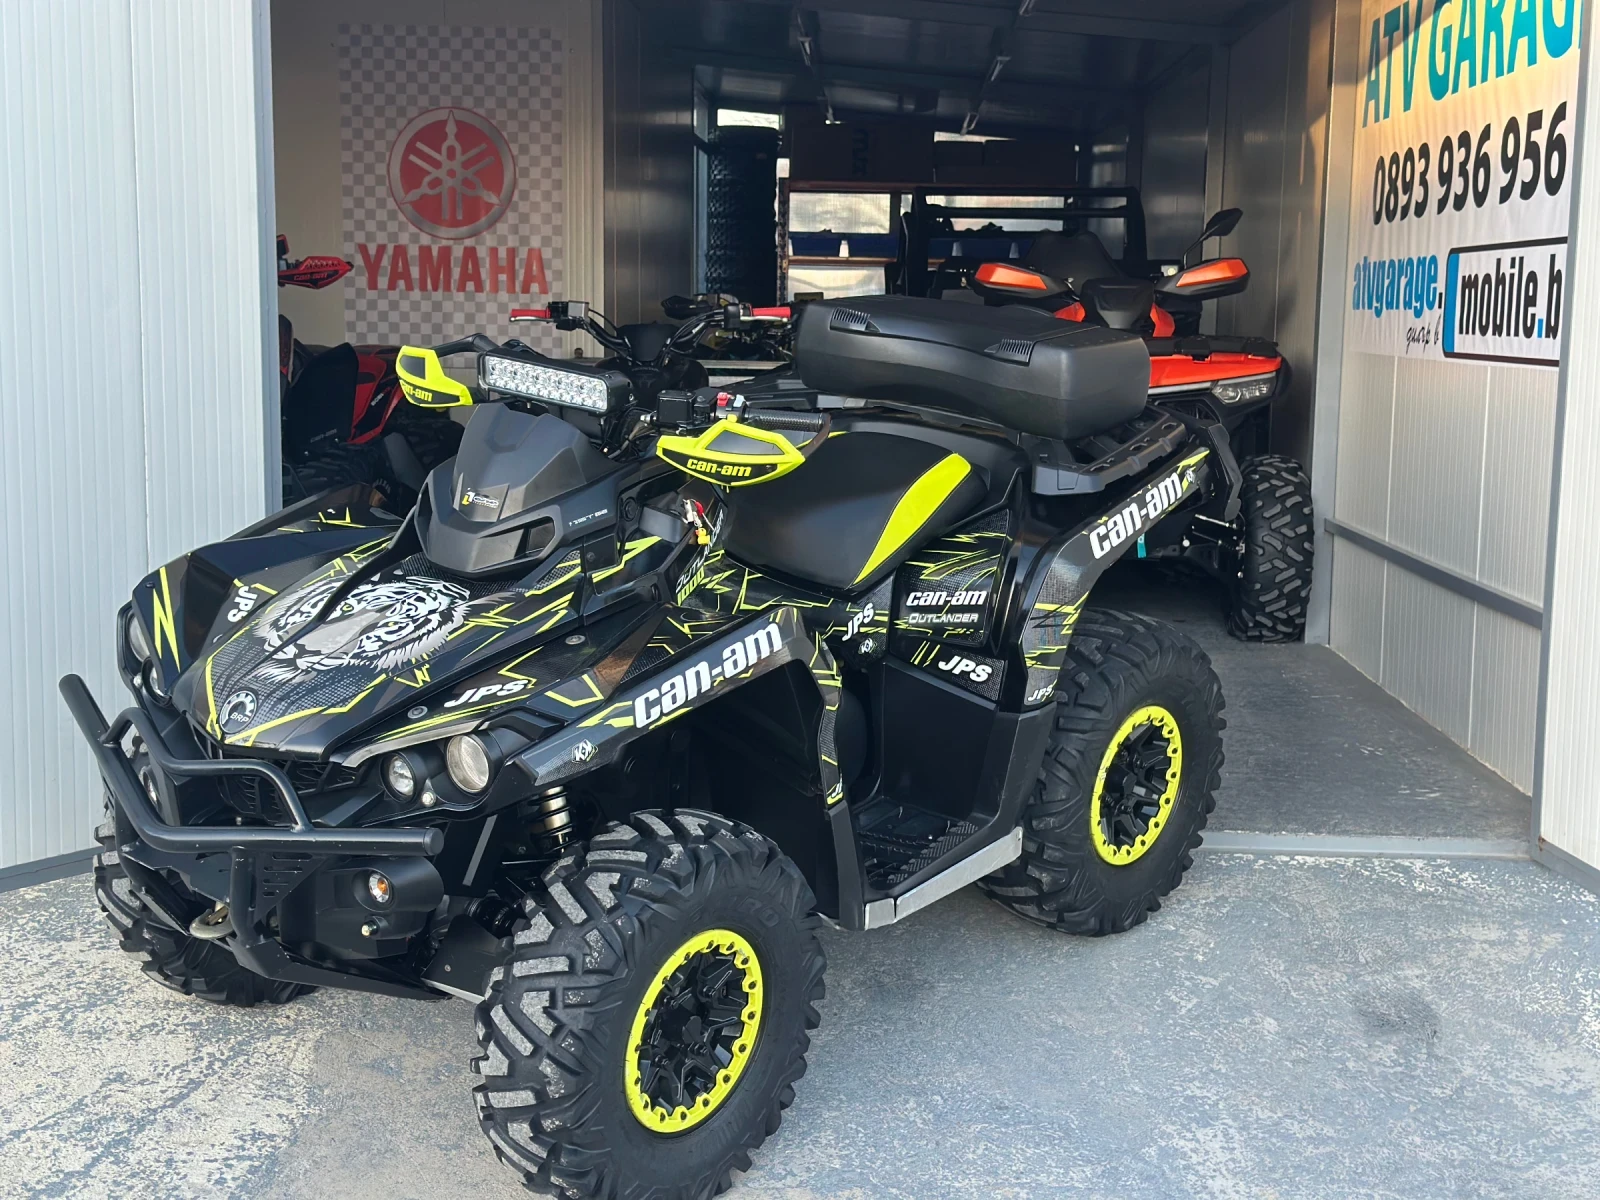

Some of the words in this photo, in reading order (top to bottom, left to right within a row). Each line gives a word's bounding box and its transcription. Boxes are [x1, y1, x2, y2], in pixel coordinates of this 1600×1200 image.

[1362, 0, 1422, 128] ATV
[1428, 0, 1582, 101] GARAG
[1373, 142, 1430, 226] 0893
[1437, 123, 1491, 215] 936
[1499, 101, 1568, 205] 956
[357, 243, 549, 294] YAMAHA
[686, 458, 752, 477] can-am
[1089, 472, 1182, 559] can-am
[227, 586, 258, 623] JPS
[906, 590, 987, 607] can-am
[842, 602, 875, 641] JPS
[908, 612, 979, 624] OUTLANDER
[633, 622, 783, 729] can-am
[938, 655, 993, 682] JPS
[443, 679, 529, 708] JPS
[1027, 684, 1054, 701] JPS
[230, 710, 249, 723] BRP
